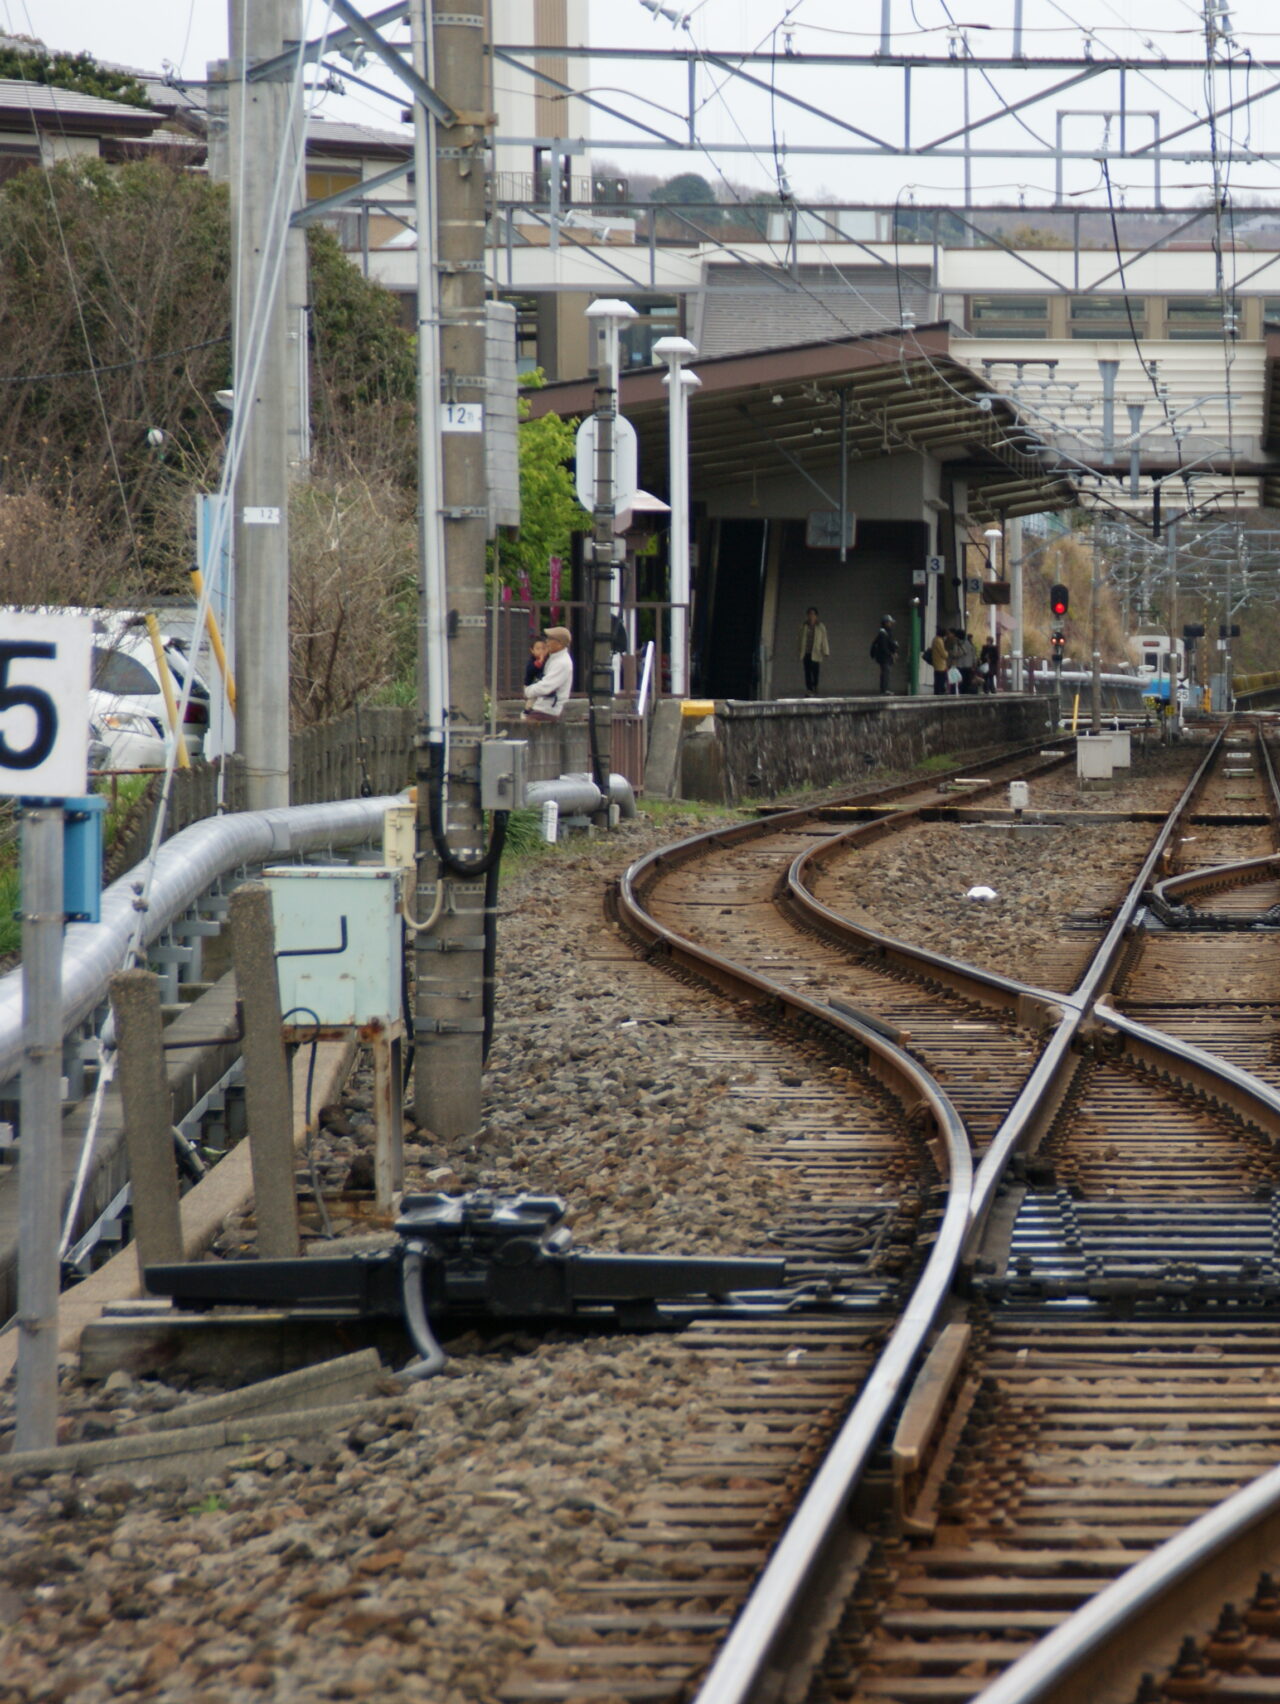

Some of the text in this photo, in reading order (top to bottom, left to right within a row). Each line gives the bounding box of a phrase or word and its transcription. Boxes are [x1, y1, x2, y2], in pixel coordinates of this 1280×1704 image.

[930, 558, 940, 571] 3
[971, 579, 980, 591] 3
[0, 640, 58, 770] 5
